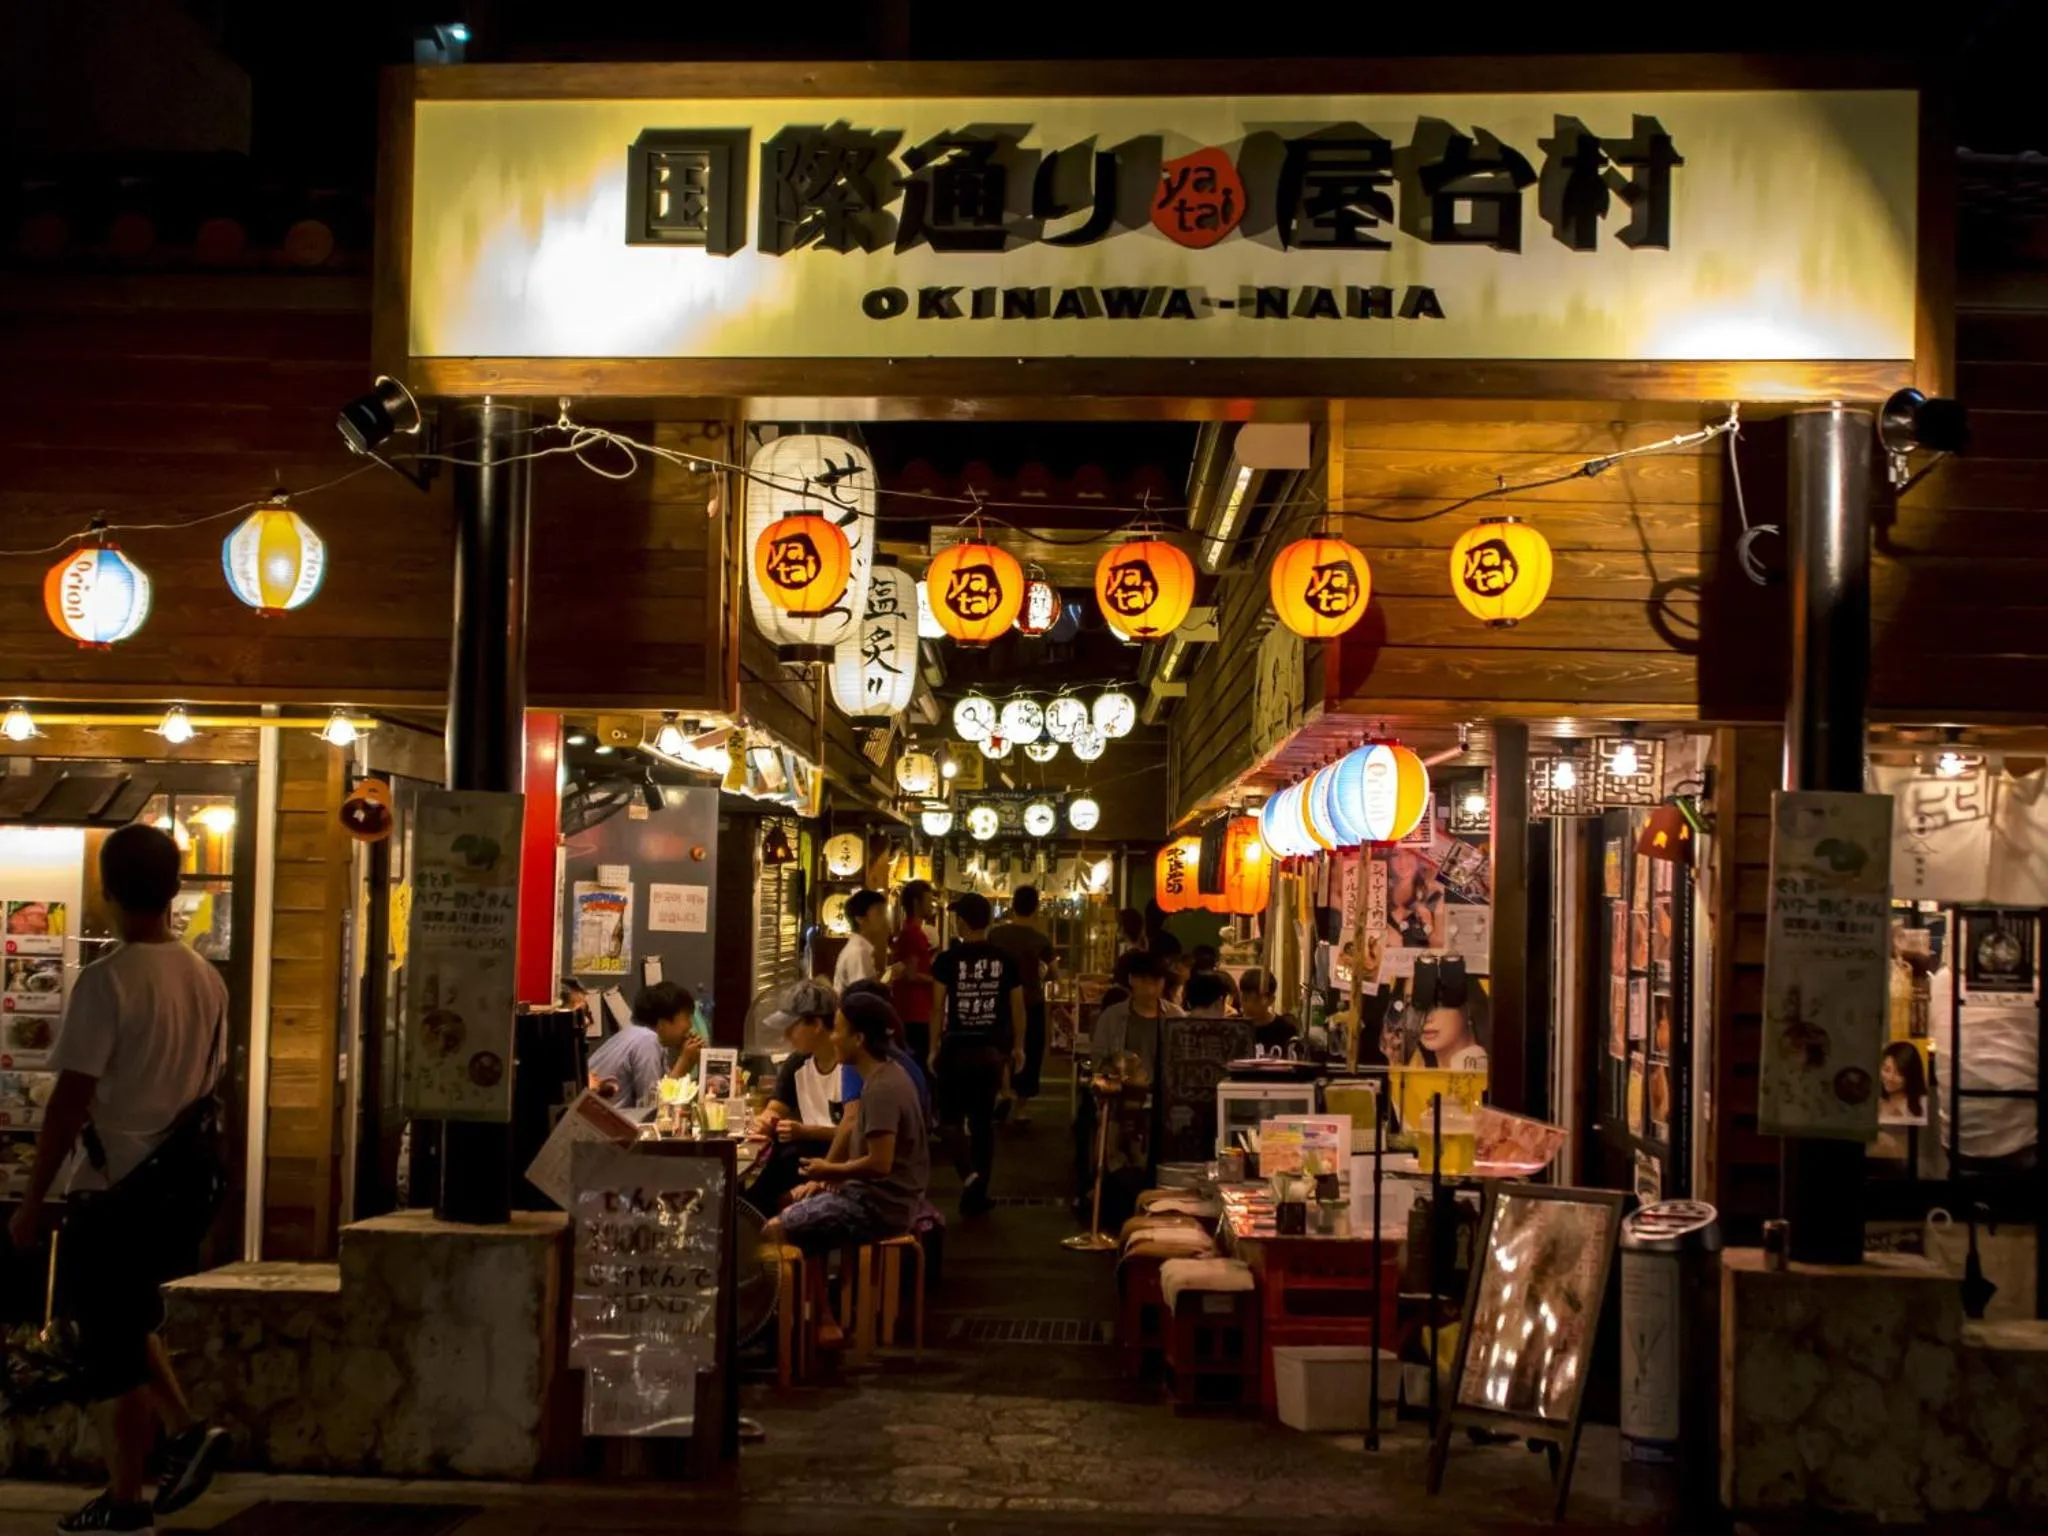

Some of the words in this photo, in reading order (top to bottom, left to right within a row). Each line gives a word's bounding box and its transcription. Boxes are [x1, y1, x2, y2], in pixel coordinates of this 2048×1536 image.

[627, 125, 1130, 254] 国際通り
[1280, 116, 1685, 253] 屋台村
[1159, 165, 1218, 208] ya
[1174, 188, 1238, 232] tai
[771, 541, 804, 569] ya
[1465, 549, 1500, 577] ya
[777, 556, 816, 584] tai
[1108, 568, 1141, 594] ya
[1308, 569, 1348, 596] ya
[1473, 560, 1514, 592] tai
[67, 560, 93, 620] Orion
[949, 572, 988, 599] ya
[1116, 582, 1151, 610] tai
[1318, 584, 1355, 612] tai
[957, 585, 997, 615] tai
